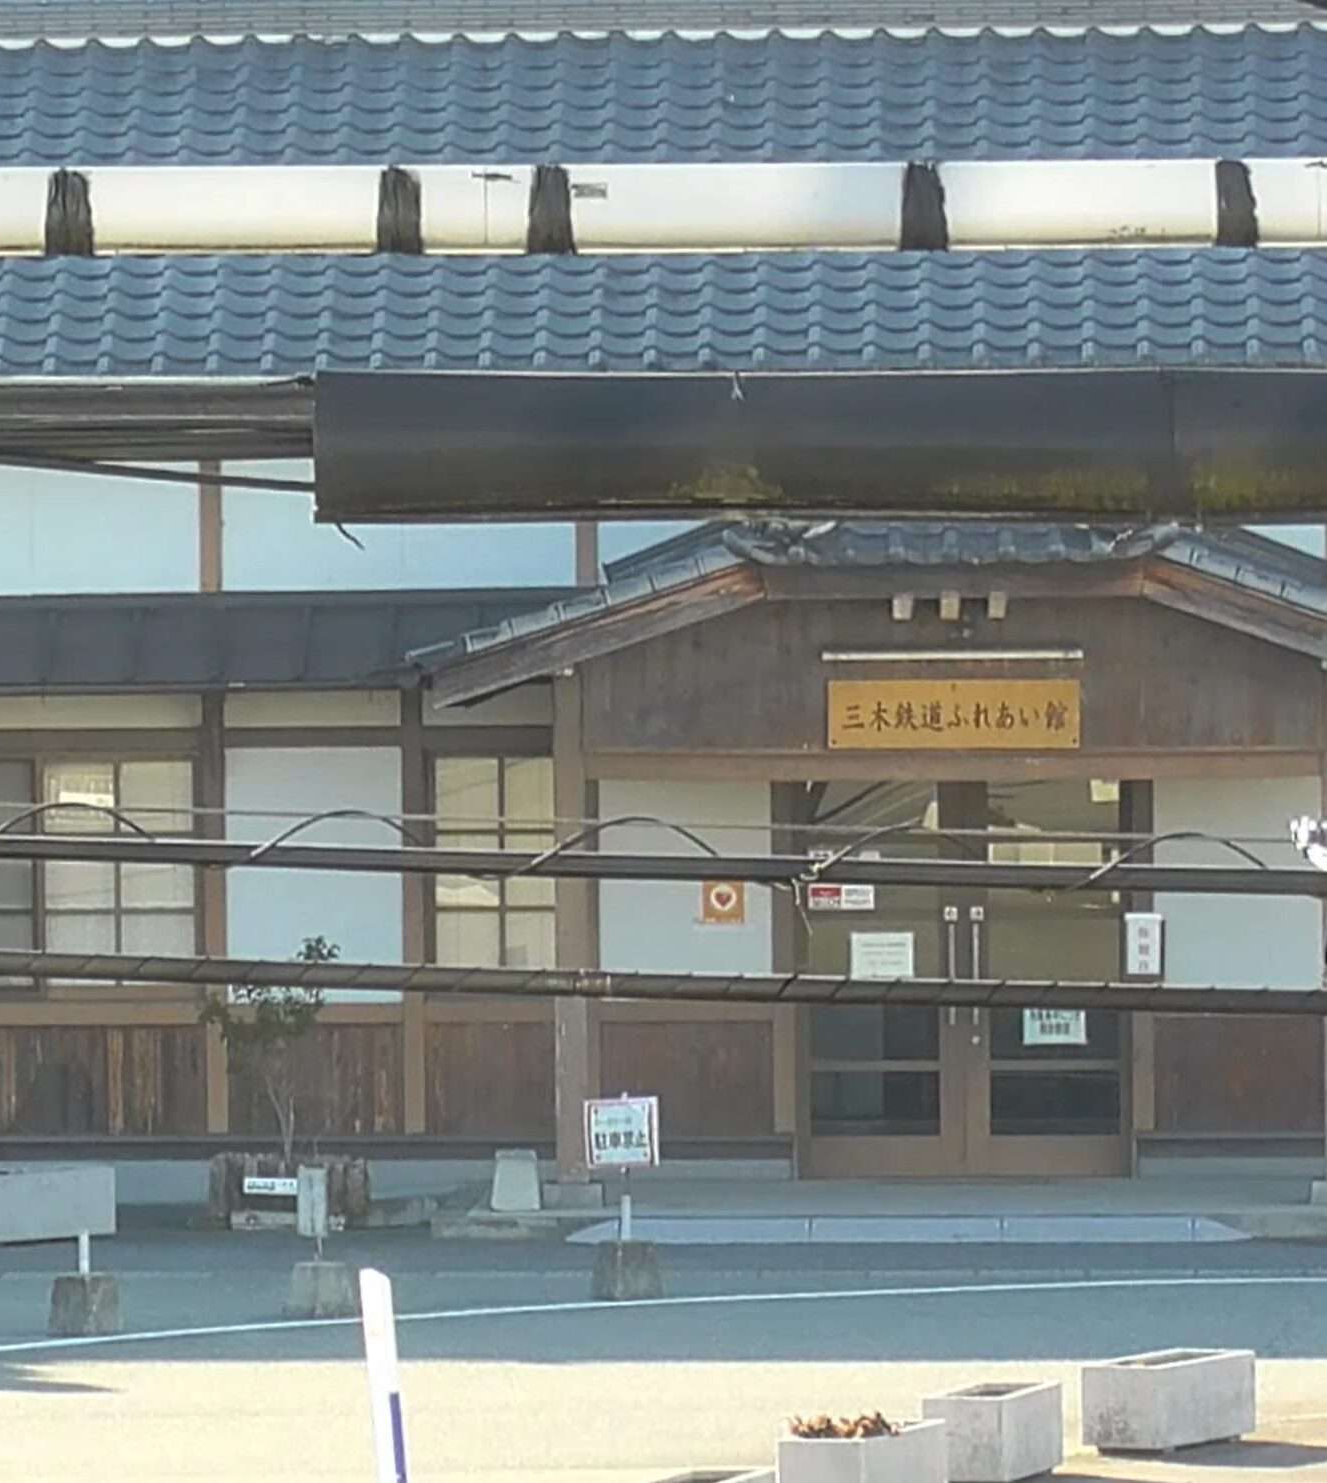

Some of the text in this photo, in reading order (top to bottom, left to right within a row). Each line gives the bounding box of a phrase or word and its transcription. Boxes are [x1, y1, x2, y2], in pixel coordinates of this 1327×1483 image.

[841, 701, 1068, 732] 三木鉄道ふれあい館
